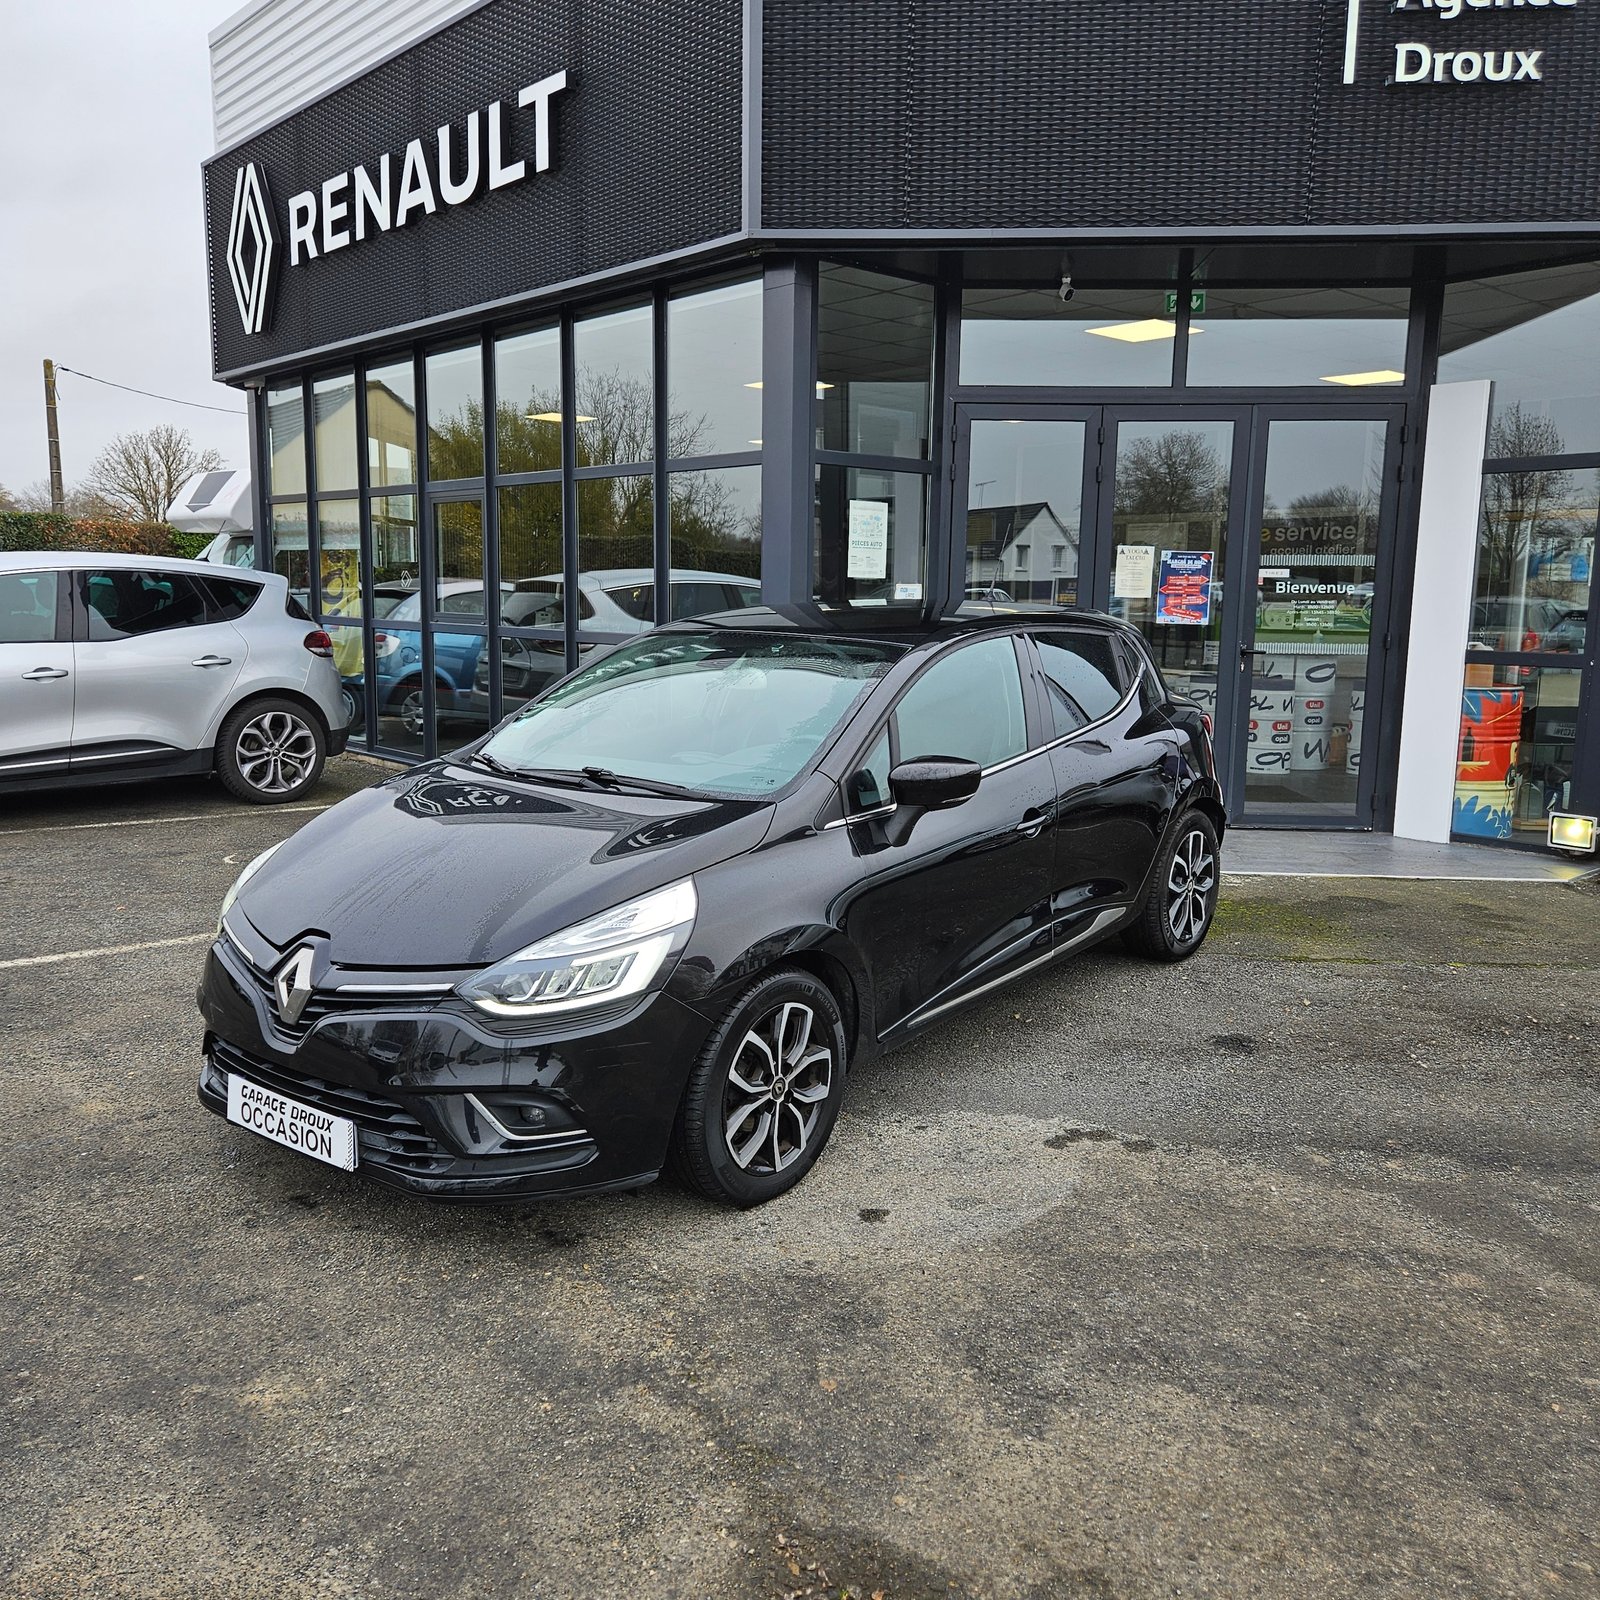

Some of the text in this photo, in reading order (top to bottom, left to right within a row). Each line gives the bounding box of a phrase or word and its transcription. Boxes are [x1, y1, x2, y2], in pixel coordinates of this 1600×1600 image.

[1394, 42, 1543, 82] Droux
[288, 69, 567, 267] RENAULT
[1274, 521, 1356, 542] service
[1270, 543, 1356, 555] accueil atelier
[1275, 581, 1356, 595] Bienvenue
[1276, 722, 1289, 730] Unil
[1275, 735, 1289, 743] opal
[241, 1084, 334, 1133] GARAGE DROUX
[241, 1101, 332, 1159] OCCASION
